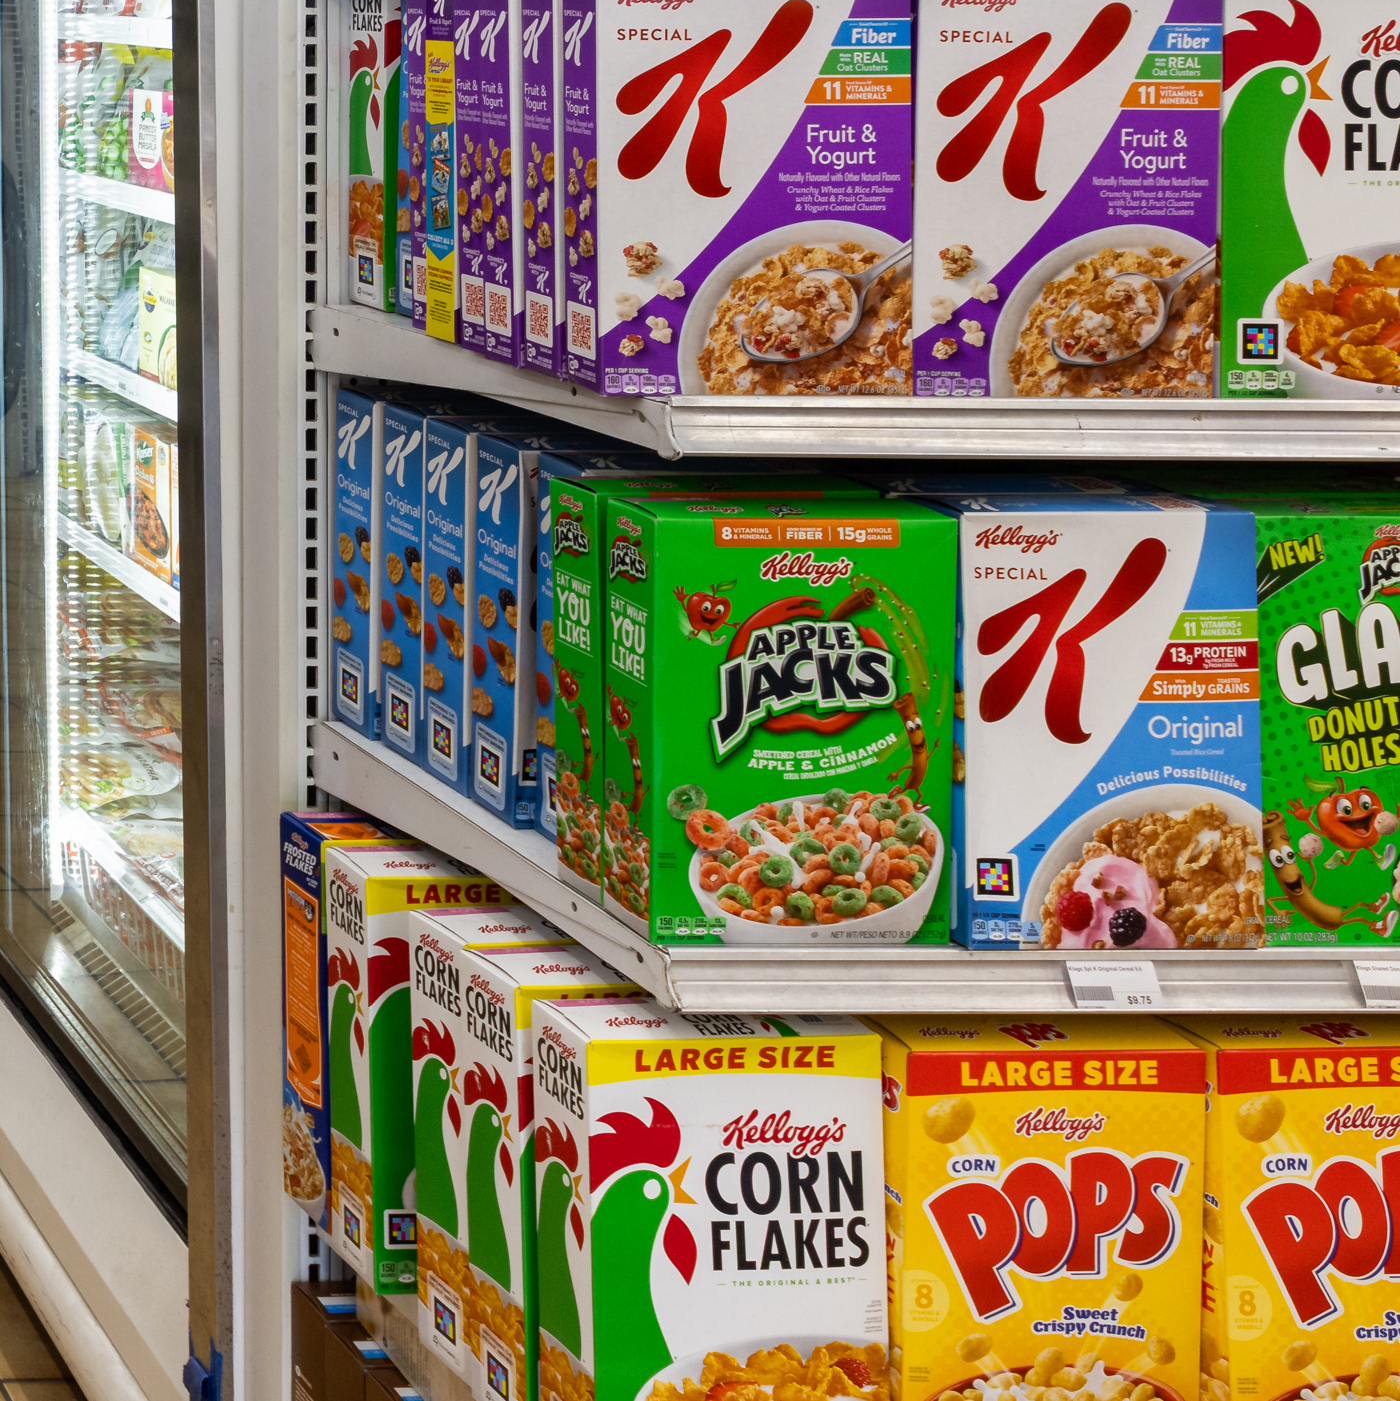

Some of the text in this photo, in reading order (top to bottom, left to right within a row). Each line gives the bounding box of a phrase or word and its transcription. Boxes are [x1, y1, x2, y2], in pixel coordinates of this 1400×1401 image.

[617, 27, 692, 42] SPECIAL
[851, 28, 896, 44] Fiber
[837, 63, 888, 72] Oat Clusters
[853, 52, 888, 63] REAL
[823, 81, 841, 100] 11
[139, 124, 157, 134] PANEER
[139, 133, 156, 142] BUTTER
[806, 123, 876, 143] Fruit &
[138, 141, 157, 150] MASALA
[806, 145, 876, 169] Yogurt
[786, 531, 824, 541] FIBER
[836, 526, 866, 545] 15g
[1269, 534, 1324, 571] NEW!
[761, 552, 853, 586] Kellogg's
[611, 595, 648, 625] EAT WHAT
[611, 612, 646, 654] YOU
[747, 622, 855, 662] APPLE
[612, 642, 645, 681] LIKE!
[1194, 646, 1246, 659] PROTEIN
[1153, 681, 1205, 699] Simply
[714, 646, 898, 762] JACKS
[1148, 714, 1243, 744] Original
[753, 745, 843, 759] SWEETENED CEREAL WITH
[747, 758, 795, 771] APPLE
[801, 761, 814, 770] &
[1097, 765, 1247, 795] Delicious Possibilities
[284, 842, 316, 866] FROSTED
[286, 854, 314, 876] FLAKES
[330, 879, 363, 924] CORN
[1127, 994, 1153, 1006] $9.75
[635, 1046, 836, 1073] LARGE SIZE
[960, 1059, 1160, 1087] LARGE SIZE
[721, 1108, 847, 1158] Kellogg's
[952, 1158, 996, 1173] CORN
[705, 1150, 863, 1216] CORN
[713, 1216, 870, 1271] FLAKES
[929, 1151, 1185, 1320] POPS
[1063, 1306, 1119, 1322] Sweet
[1089, 1321, 1146, 1339] Crunch
